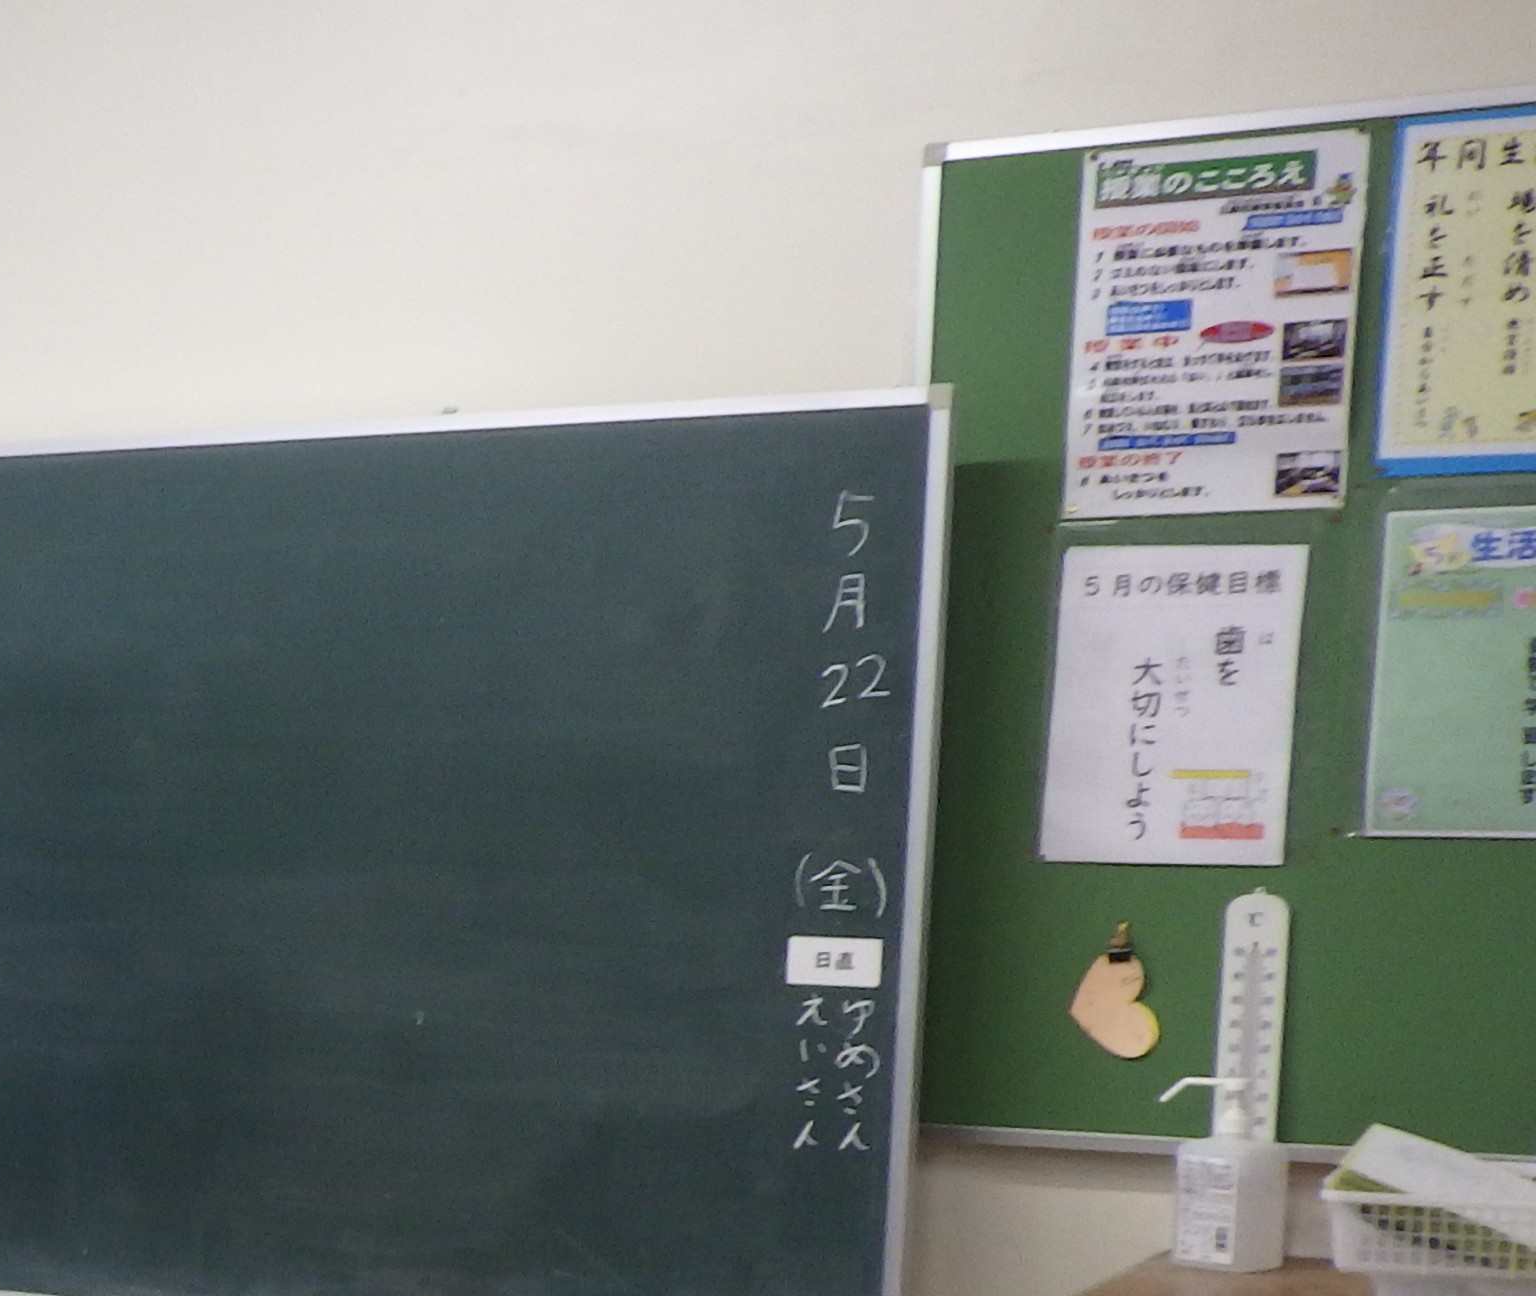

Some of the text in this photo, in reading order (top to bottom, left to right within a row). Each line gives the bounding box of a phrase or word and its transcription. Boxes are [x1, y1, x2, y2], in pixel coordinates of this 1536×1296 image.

[1083, 568, 1283, 599] 5月の保健目標
[1214, 625, 1246, 687] 歯を
[1126, 656, 1164, 842] 大切にしよう
[815, 951, 856, 971] 日直
